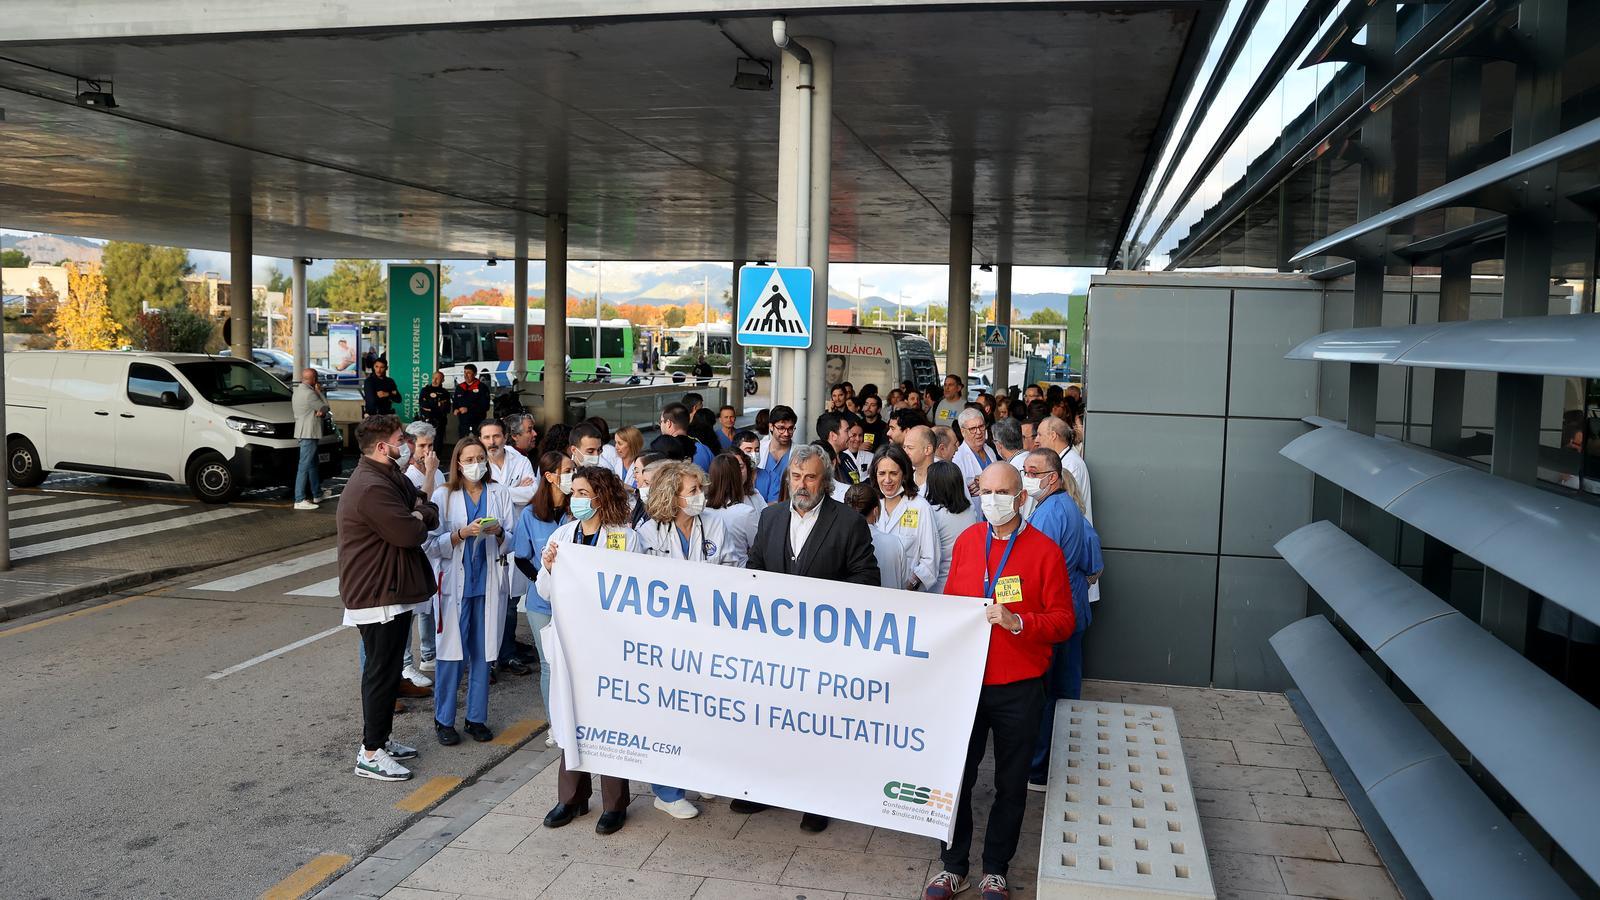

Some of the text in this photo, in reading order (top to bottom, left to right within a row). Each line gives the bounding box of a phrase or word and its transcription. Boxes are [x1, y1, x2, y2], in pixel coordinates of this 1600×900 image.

[826, 343, 883, 356] MBULÀNCIA
[998, 589, 1020, 597] HUELGA
[597, 572, 930, 659] VAGA NACIONAL
[623, 640, 890, 704] PER UN ESTATUT PROPI
[597, 676, 926, 752] PELS METGES I FACULTATIUS
[576, 725, 682, 756] SIMEBAL CESM
[882, 800, 951, 819] Confederación Estatal
[883, 781, 953, 812] CESM
[891, 809, 925, 823] Sindicatos
[926, 817, 951, 827] Médico
